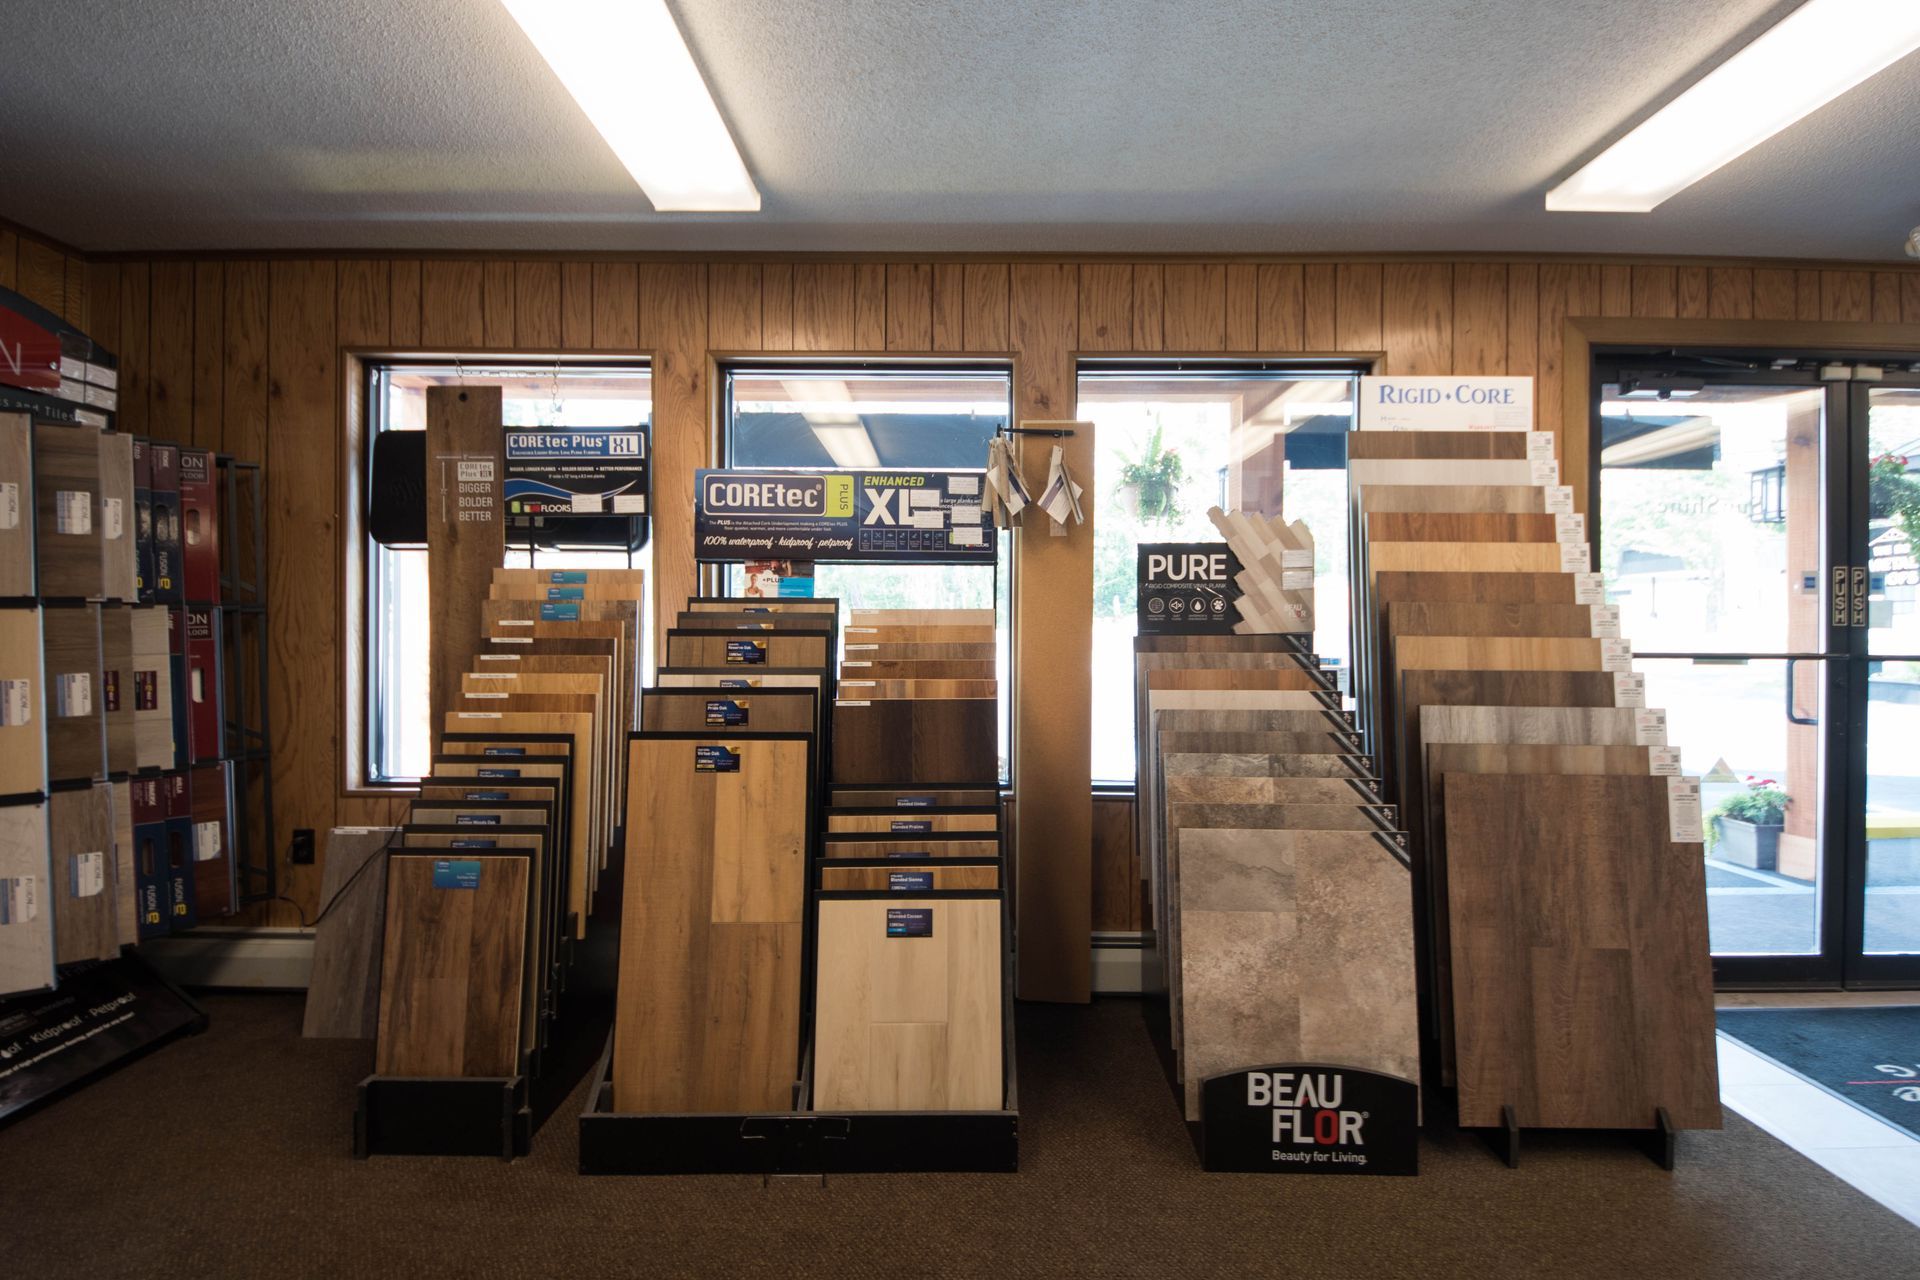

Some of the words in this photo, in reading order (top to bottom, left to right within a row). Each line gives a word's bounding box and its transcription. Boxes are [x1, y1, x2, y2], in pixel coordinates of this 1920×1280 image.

[1379, 385, 1440, 404] RIGID
[1456, 384, 1515, 404] CORE
[613, 437, 636, 454] XL
[459, 483, 492, 493] BIGGER
[864, 476, 925, 486] ENHANCED
[459, 496, 494, 507] BOLDER
[840, 483, 850, 511] PLUS
[459, 510, 492, 521] BETTER
[540, 504, 572, 513] FLOORS
[703, 536, 728, 546] 100%
[1147, 554, 1227, 581] PURE
[1835, 570, 1845, 624] PUSH
[1854, 570, 1864, 624] PUSH
[1247, 1072, 1343, 1109] BEAU
[1272, 1108, 1365, 1146] FLOR
[1272, 1150, 1312, 1164] Beauty
[1313, 1151, 1329, 1162] for
